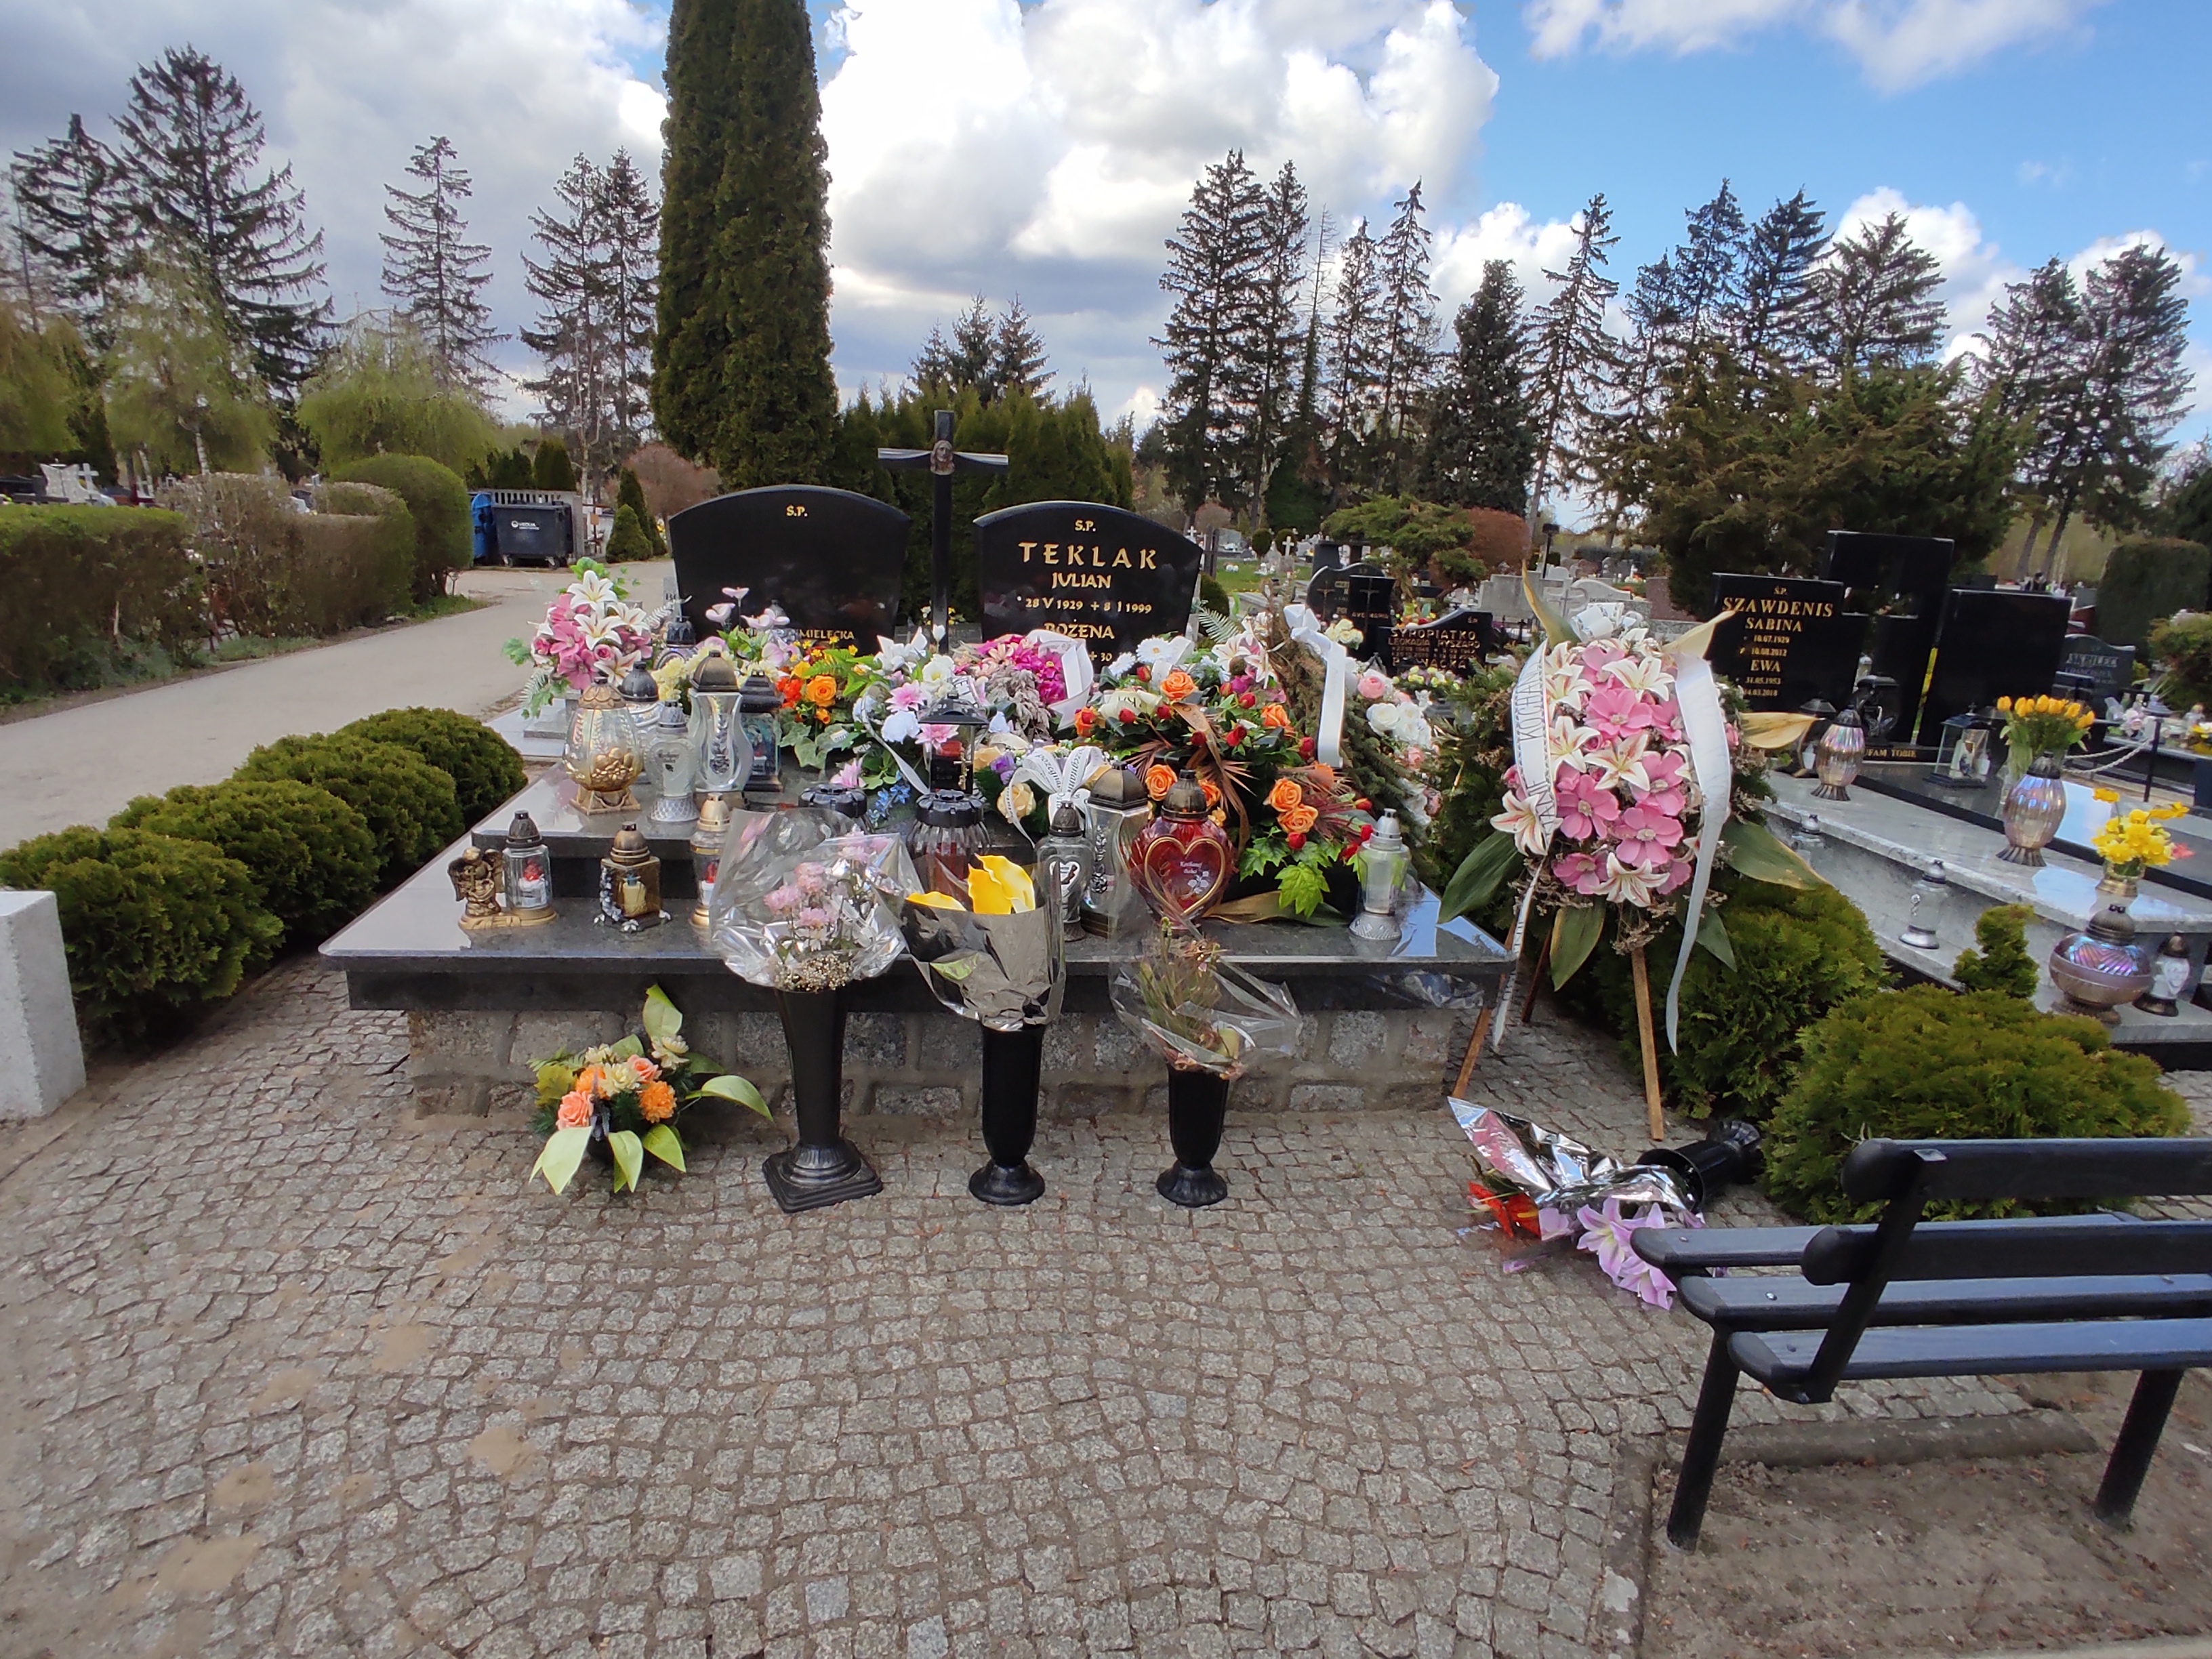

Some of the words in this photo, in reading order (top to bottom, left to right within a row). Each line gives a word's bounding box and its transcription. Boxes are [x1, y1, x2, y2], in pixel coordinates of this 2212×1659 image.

[1018, 542, 1156, 570] TEKLAK
[1052, 572, 1111, 589] JULIAN
[1025, 598, 1040, 609] 28
[1042, 597, 1054, 609] V
[1057, 599, 1084, 611] 1929
[1104, 601, 1111, 611] 8
[1126, 602, 1152, 614] 1999
[1722, 596, 1834, 617] SZAWDENIS
[1044, 619, 1115, 640] BOŻENA
[1745, 617, 1803, 632] SABINA
[799, 629, 855, 640] MIELECKA
[1391, 628, 1476, 640] SYROPIATKO
[1101, 652, 1113, 661] 30
[1750, 659, 1780, 672] EWA
